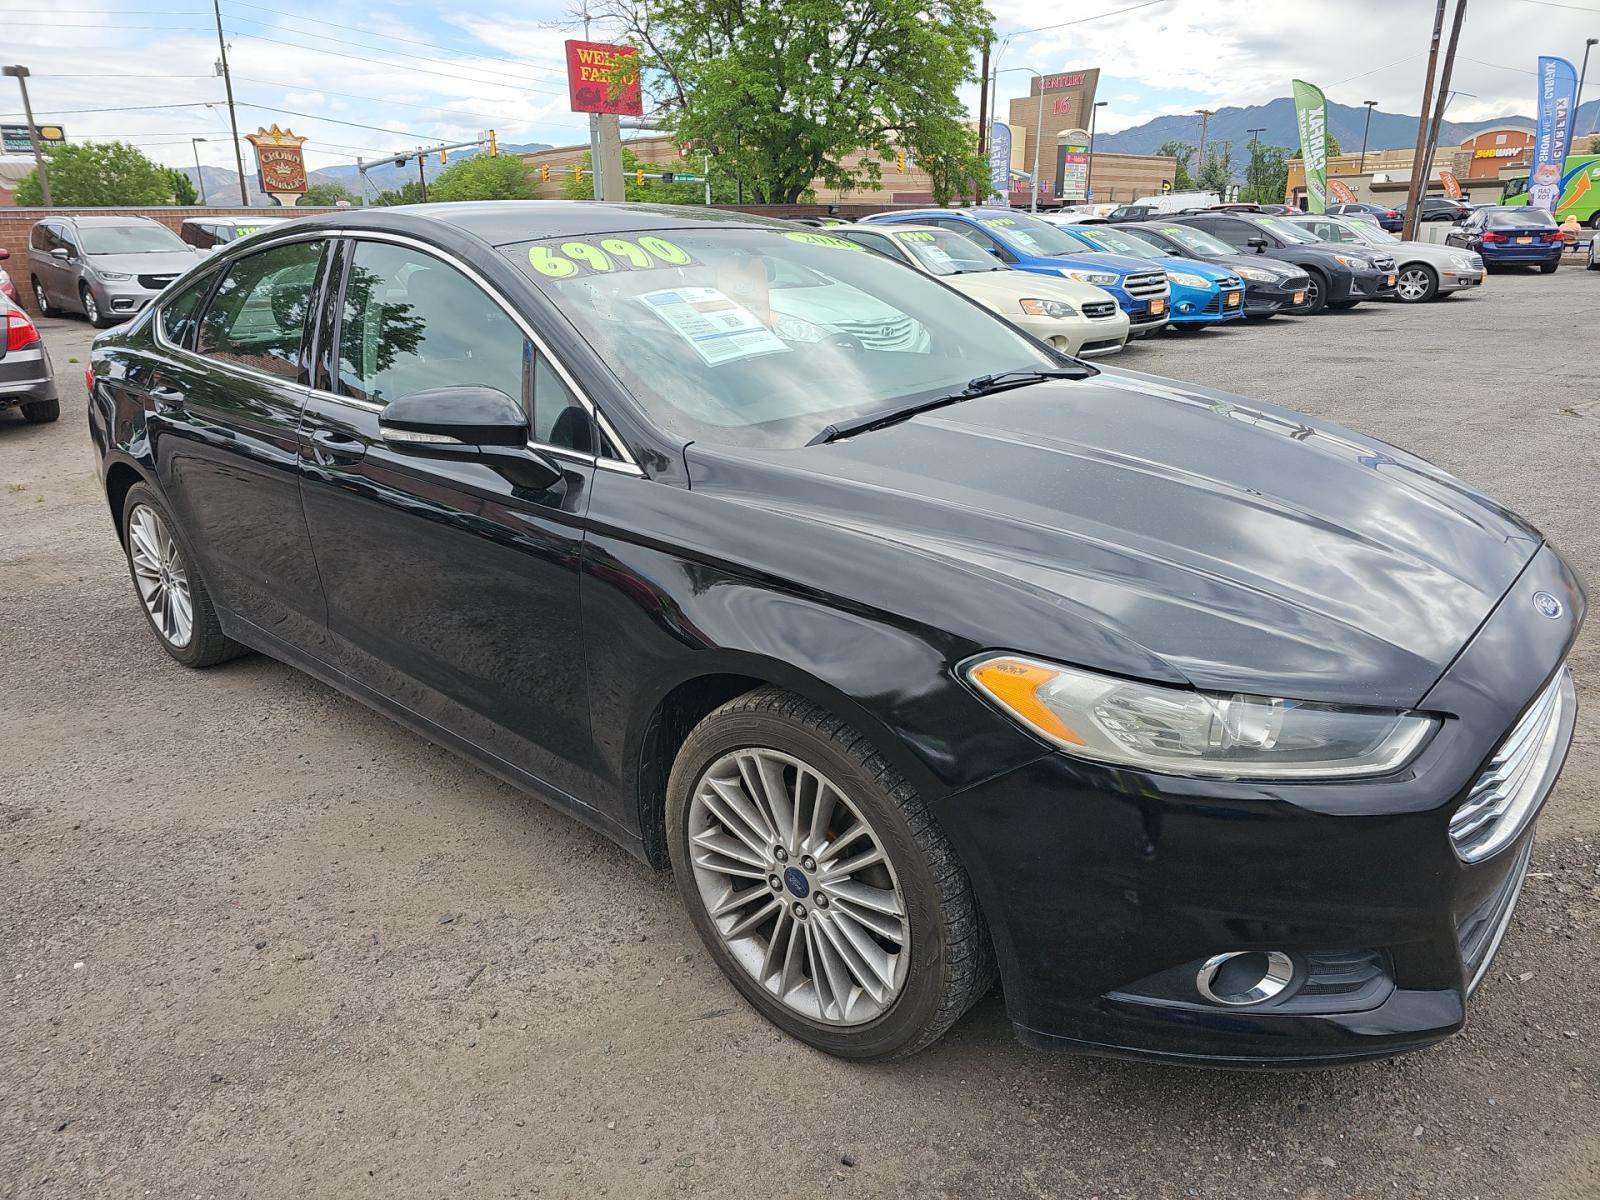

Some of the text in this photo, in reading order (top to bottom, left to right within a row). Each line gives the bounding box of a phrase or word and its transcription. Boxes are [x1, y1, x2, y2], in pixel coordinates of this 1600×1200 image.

[576, 49, 635, 67] WEL
[580, 66, 636, 85] FARO
[1052, 97, 1073, 115] 16
[1474, 146, 1523, 159] SUBWAY
[528, 236, 692, 277] 6990
